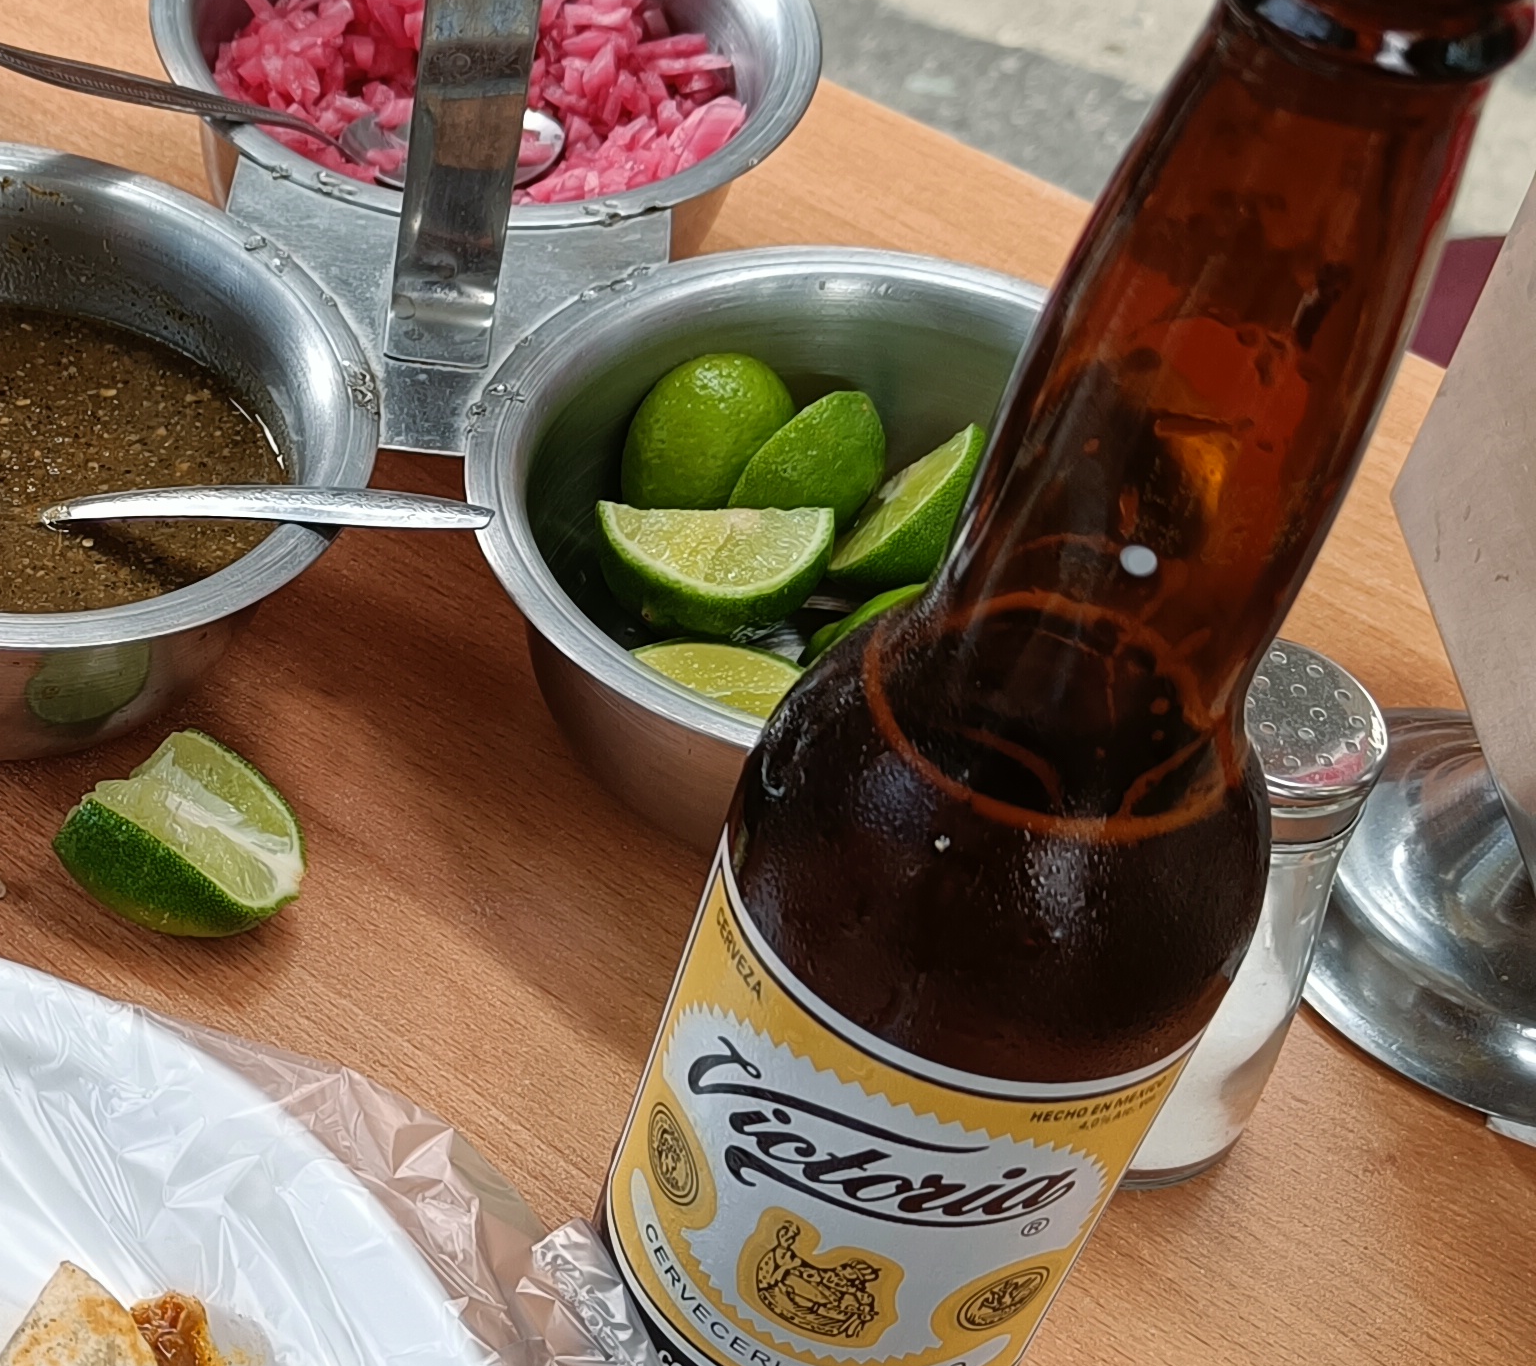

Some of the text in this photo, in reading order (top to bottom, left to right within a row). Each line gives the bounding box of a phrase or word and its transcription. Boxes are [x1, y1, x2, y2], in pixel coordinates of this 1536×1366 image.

[717, 906, 762, 1002] CERVEZA
[687, 1035, 1077, 1228] Victoria
[1030, 1106, 1088, 1123] HECHO
[1091, 1099, 1114, 1117] EN
